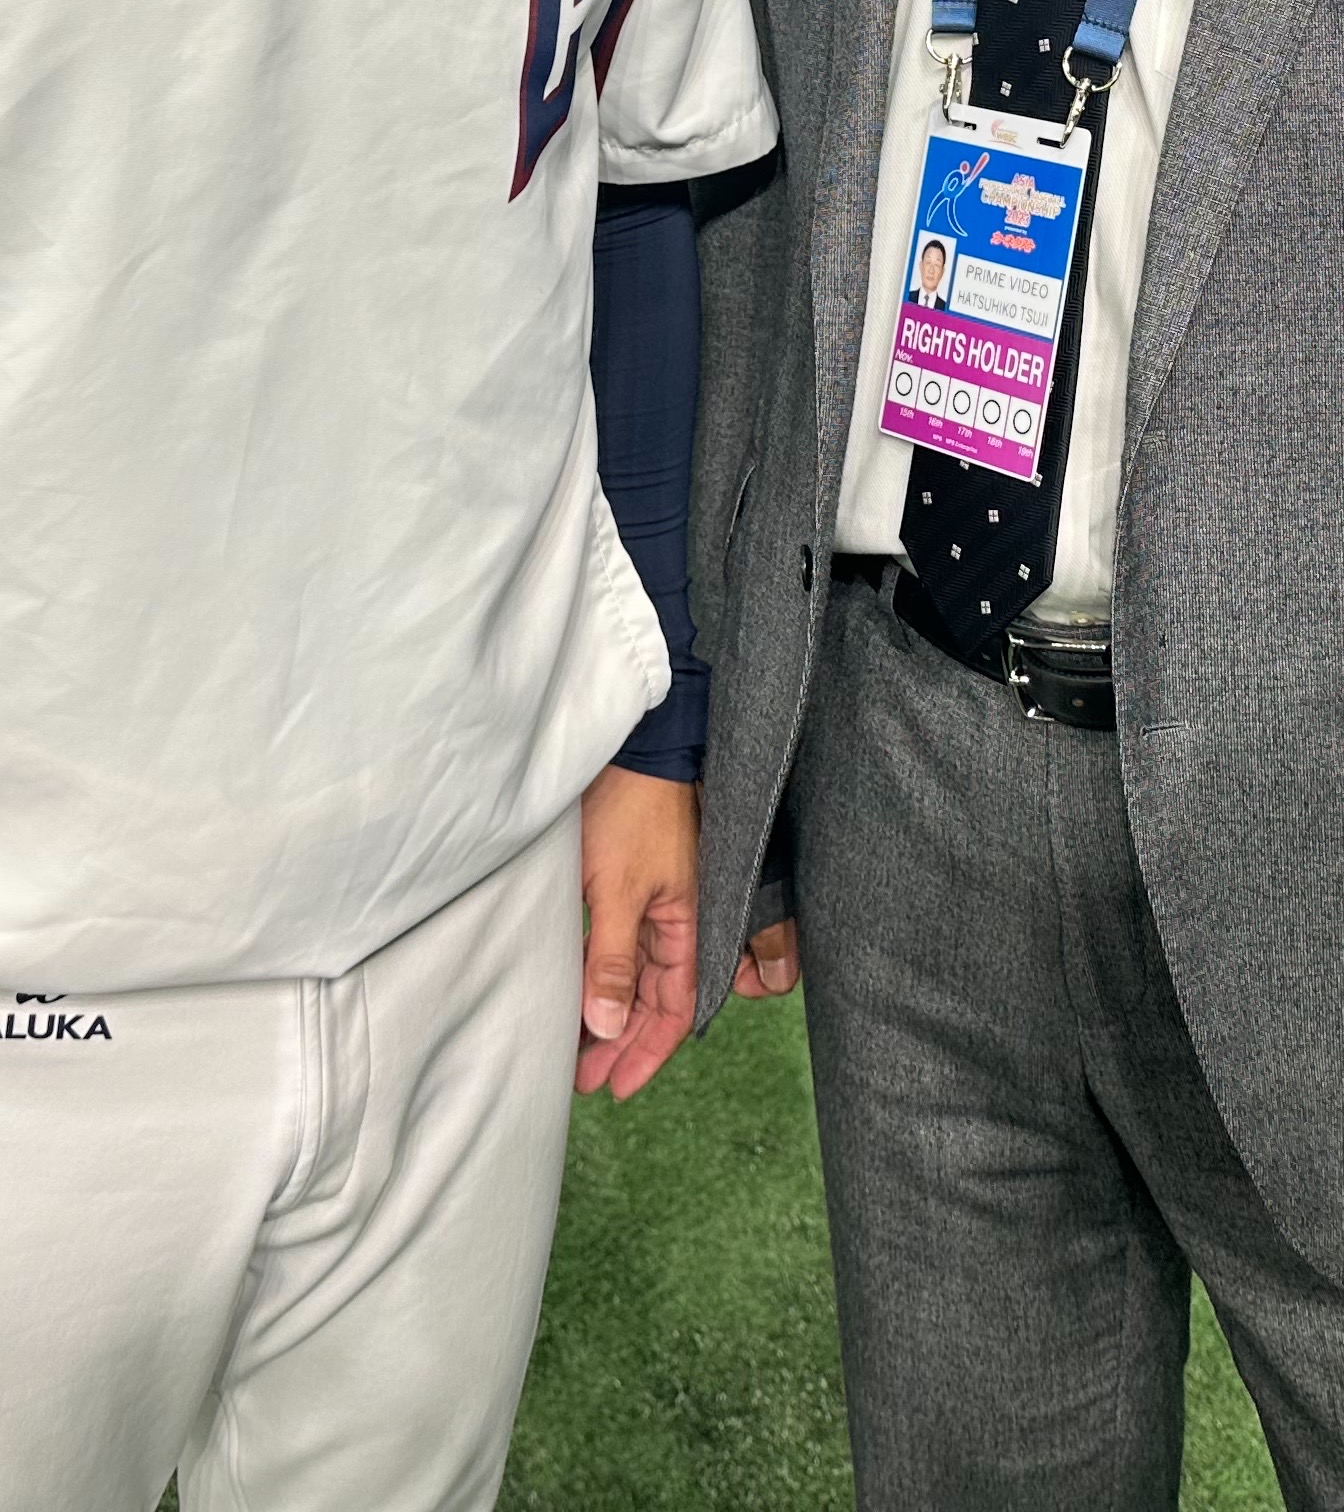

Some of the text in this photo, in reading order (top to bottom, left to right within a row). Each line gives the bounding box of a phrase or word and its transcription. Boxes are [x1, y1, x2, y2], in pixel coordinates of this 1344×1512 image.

[965, 264, 1049, 299] PRIME VIDEO
[957, 290, 1049, 327] HATSUHIKO TSUJI
[900, 317, 1045, 388] RIGHTS HOLDER
[957, 426, 973, 438] 17th
